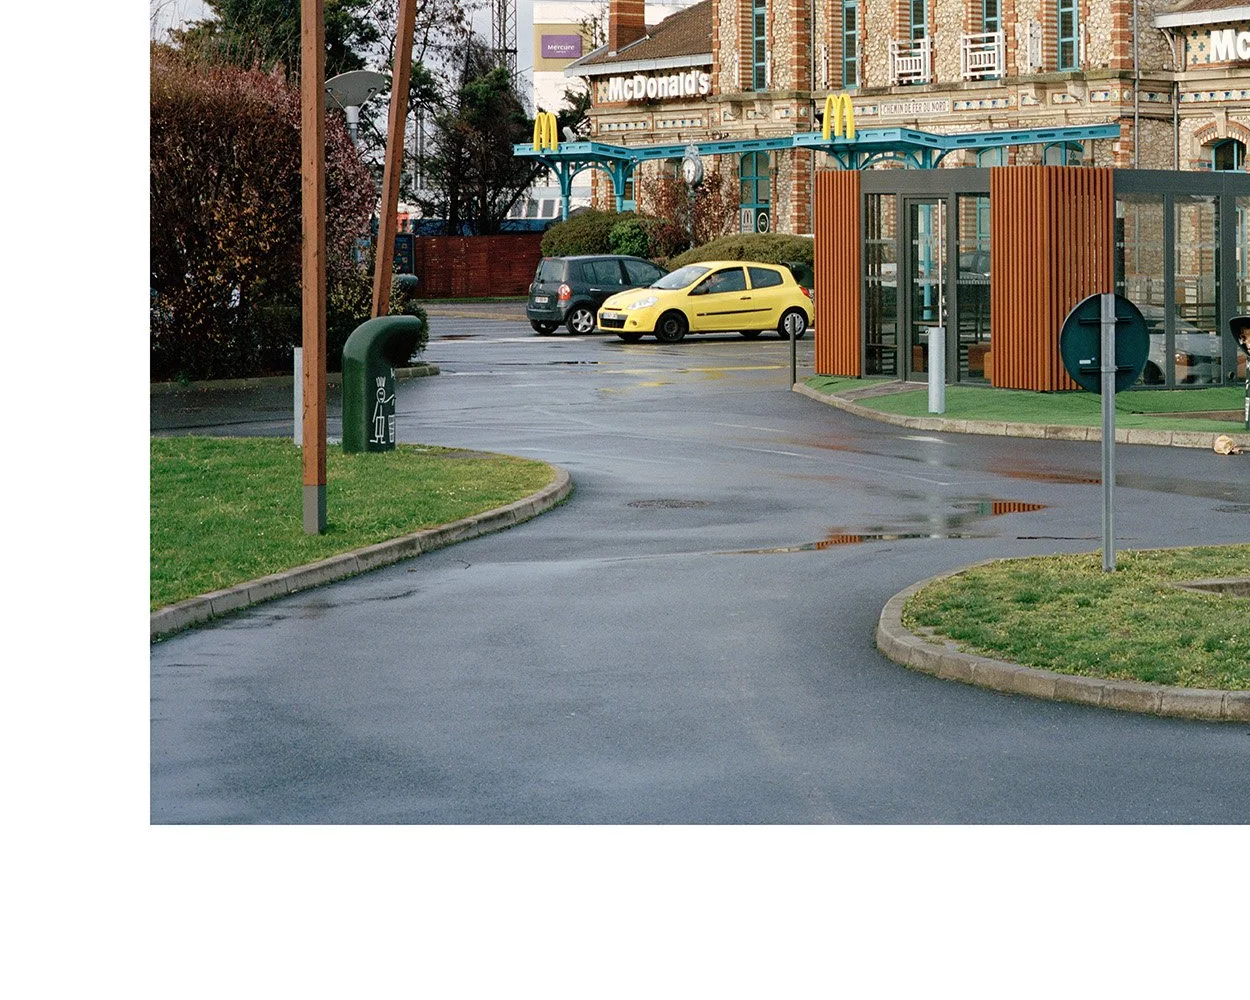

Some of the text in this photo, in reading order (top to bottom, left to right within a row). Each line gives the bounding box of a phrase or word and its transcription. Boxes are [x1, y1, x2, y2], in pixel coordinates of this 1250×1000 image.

[608, 70, 712, 101] McDonald's
[884, 101, 946, 114] CHEMIN DE FER DU NORD
